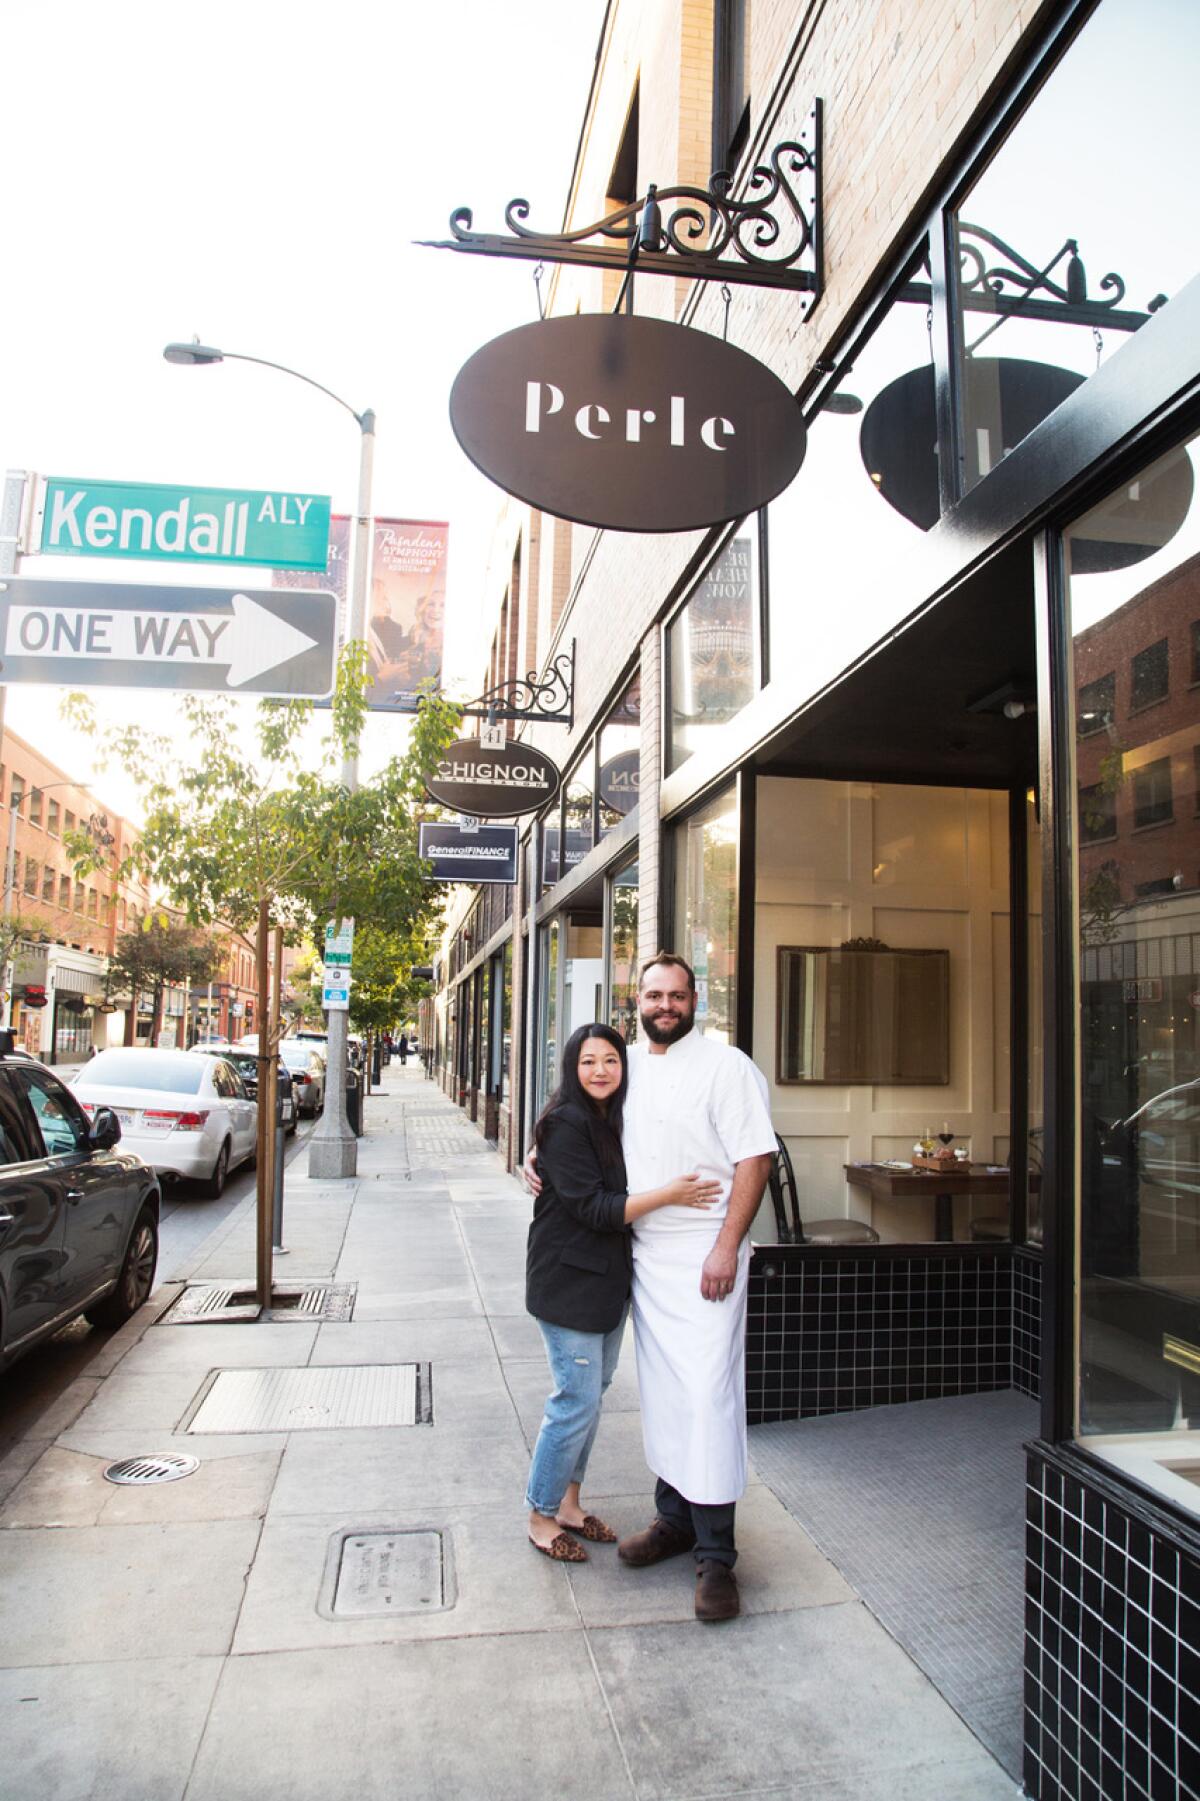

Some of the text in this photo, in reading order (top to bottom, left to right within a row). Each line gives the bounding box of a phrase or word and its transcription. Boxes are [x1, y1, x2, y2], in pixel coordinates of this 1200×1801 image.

[525, 381, 736, 451] Perle
[50, 490, 313, 556] Kendall ALY
[375, 528, 443, 550] Pasadena
[384, 547, 445, 558] SYMPHONY
[19, 611, 230, 658] ONE WAY
[484, 727, 501, 743] 41
[437, 760, 546, 782] CHIGNON
[463, 817, 476, 829] 39
